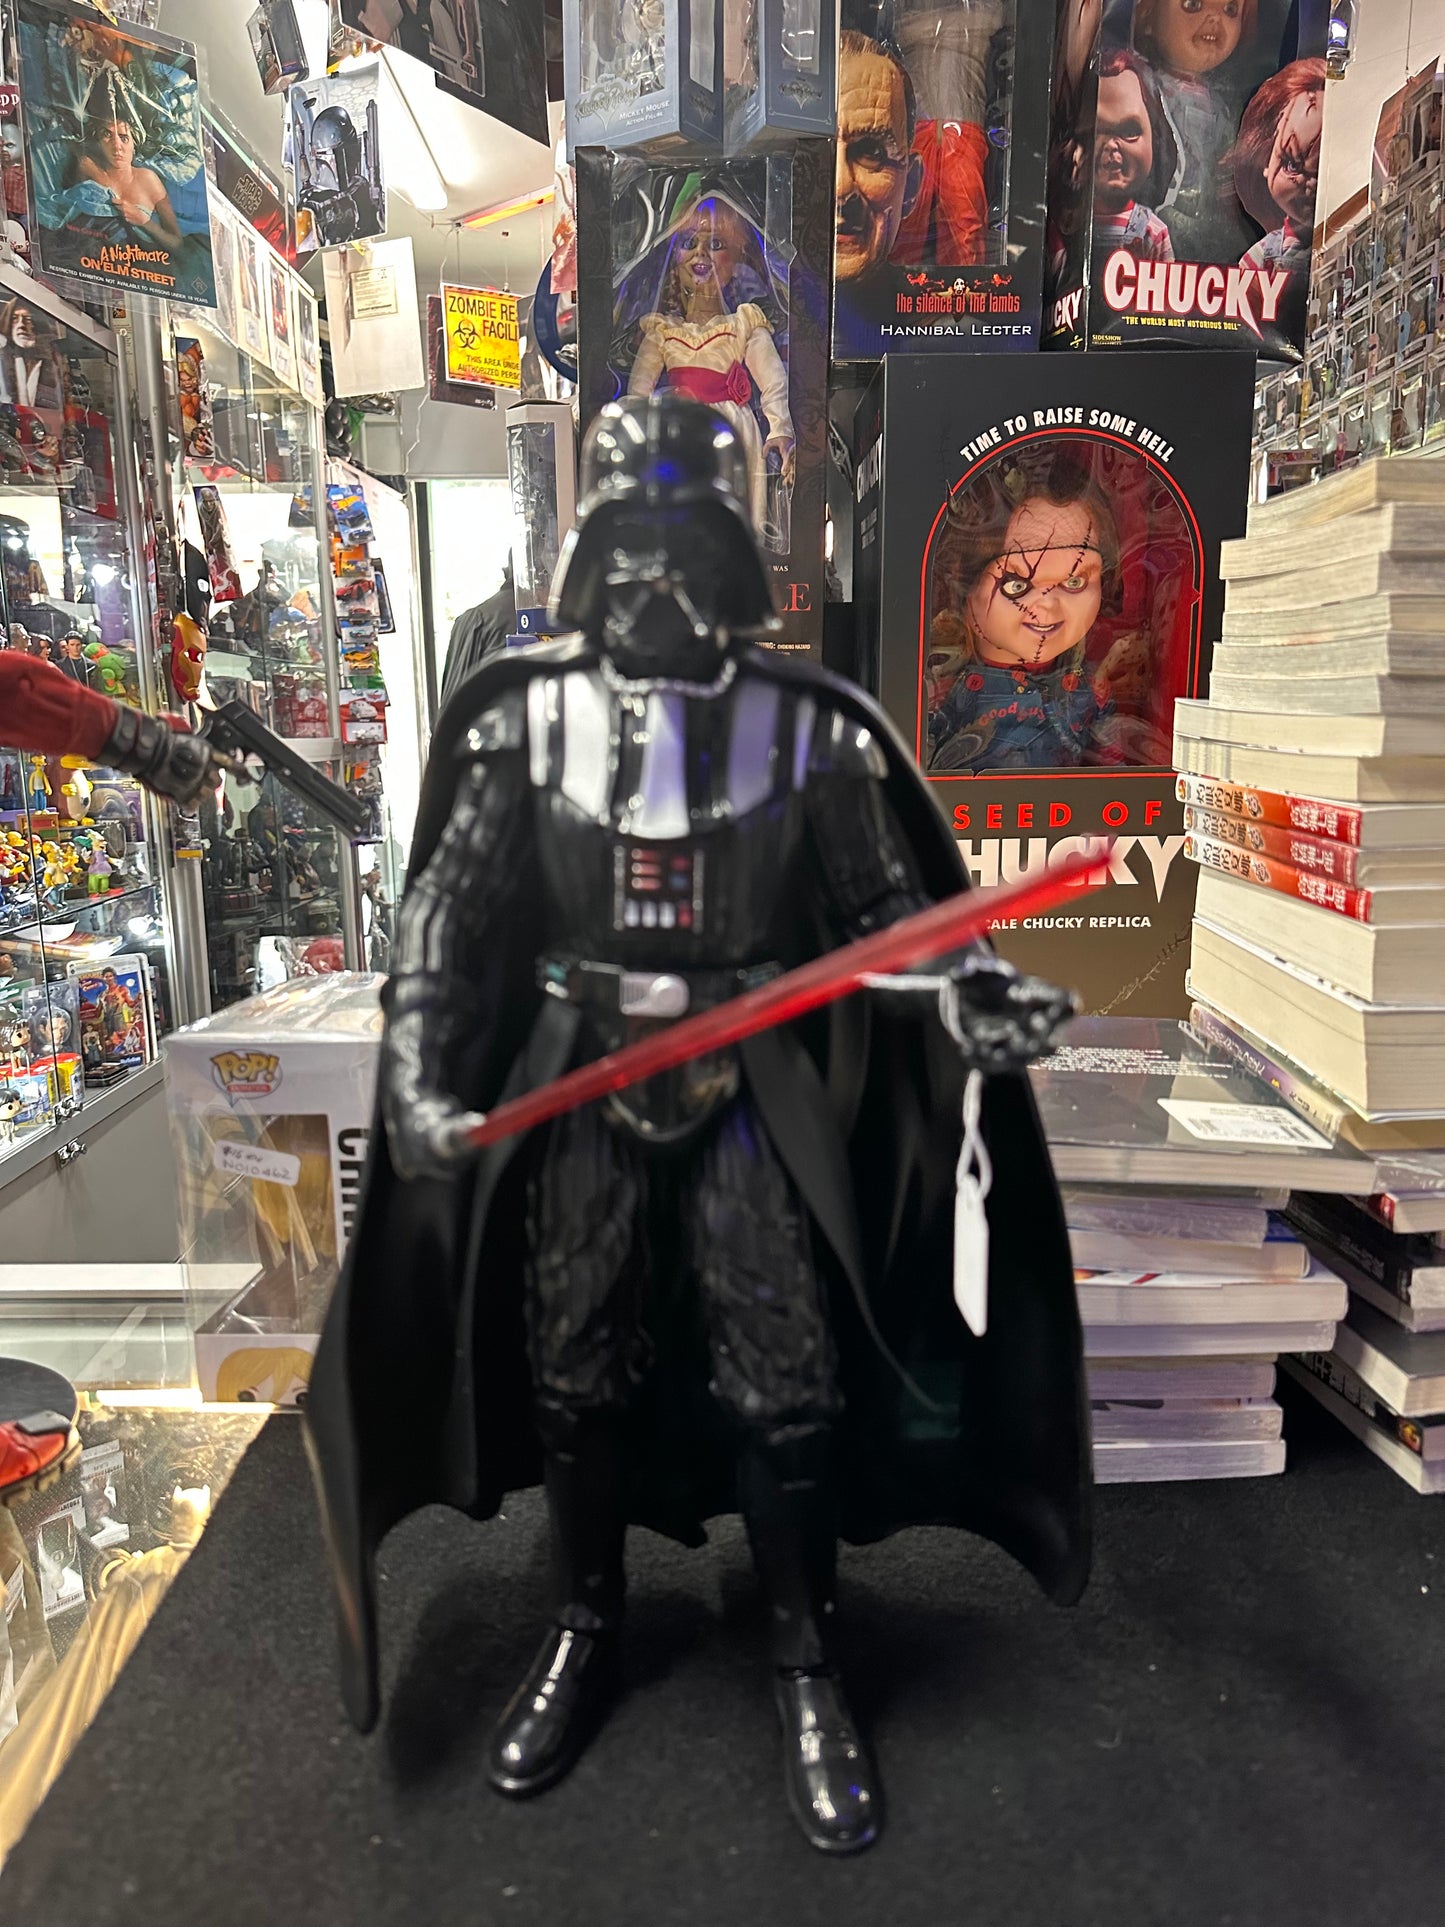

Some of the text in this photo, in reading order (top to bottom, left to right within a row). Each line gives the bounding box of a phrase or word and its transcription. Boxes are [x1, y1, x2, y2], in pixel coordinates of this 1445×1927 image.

[620, 100, 670, 120] MICKEY MOUSE
[110, 243, 171, 268] Nightmare
[80, 256, 176, 286] ON ELM STREET
[916, 293, 952, 313] silence
[989, 292, 1020, 313] lambs
[1103, 248, 1290, 342] CHUCKY
[448, 296, 516, 322] ZOMBIE RE
[482, 320, 518, 342] FACILI
[880, 324, 1032, 336] HANNIBAL LECTER
[1168, 318, 1186, 328] MOST
[1187, 320, 1222, 330] NOTORIOUS
[458, 364, 500, 377] AUTHORIZED
[466, 354, 520, 370] THIS AREA UNDE
[960, 407, 1175, 463] TIME TO RAISE SOME HELL
[952, 800, 1162, 830] SEED OF
[955, 834, 1187, 904] HUCKY
[987, 916, 1152, 930] ALE CHUCKY REPLICA
[210, 1050, 280, 1086] POP!
